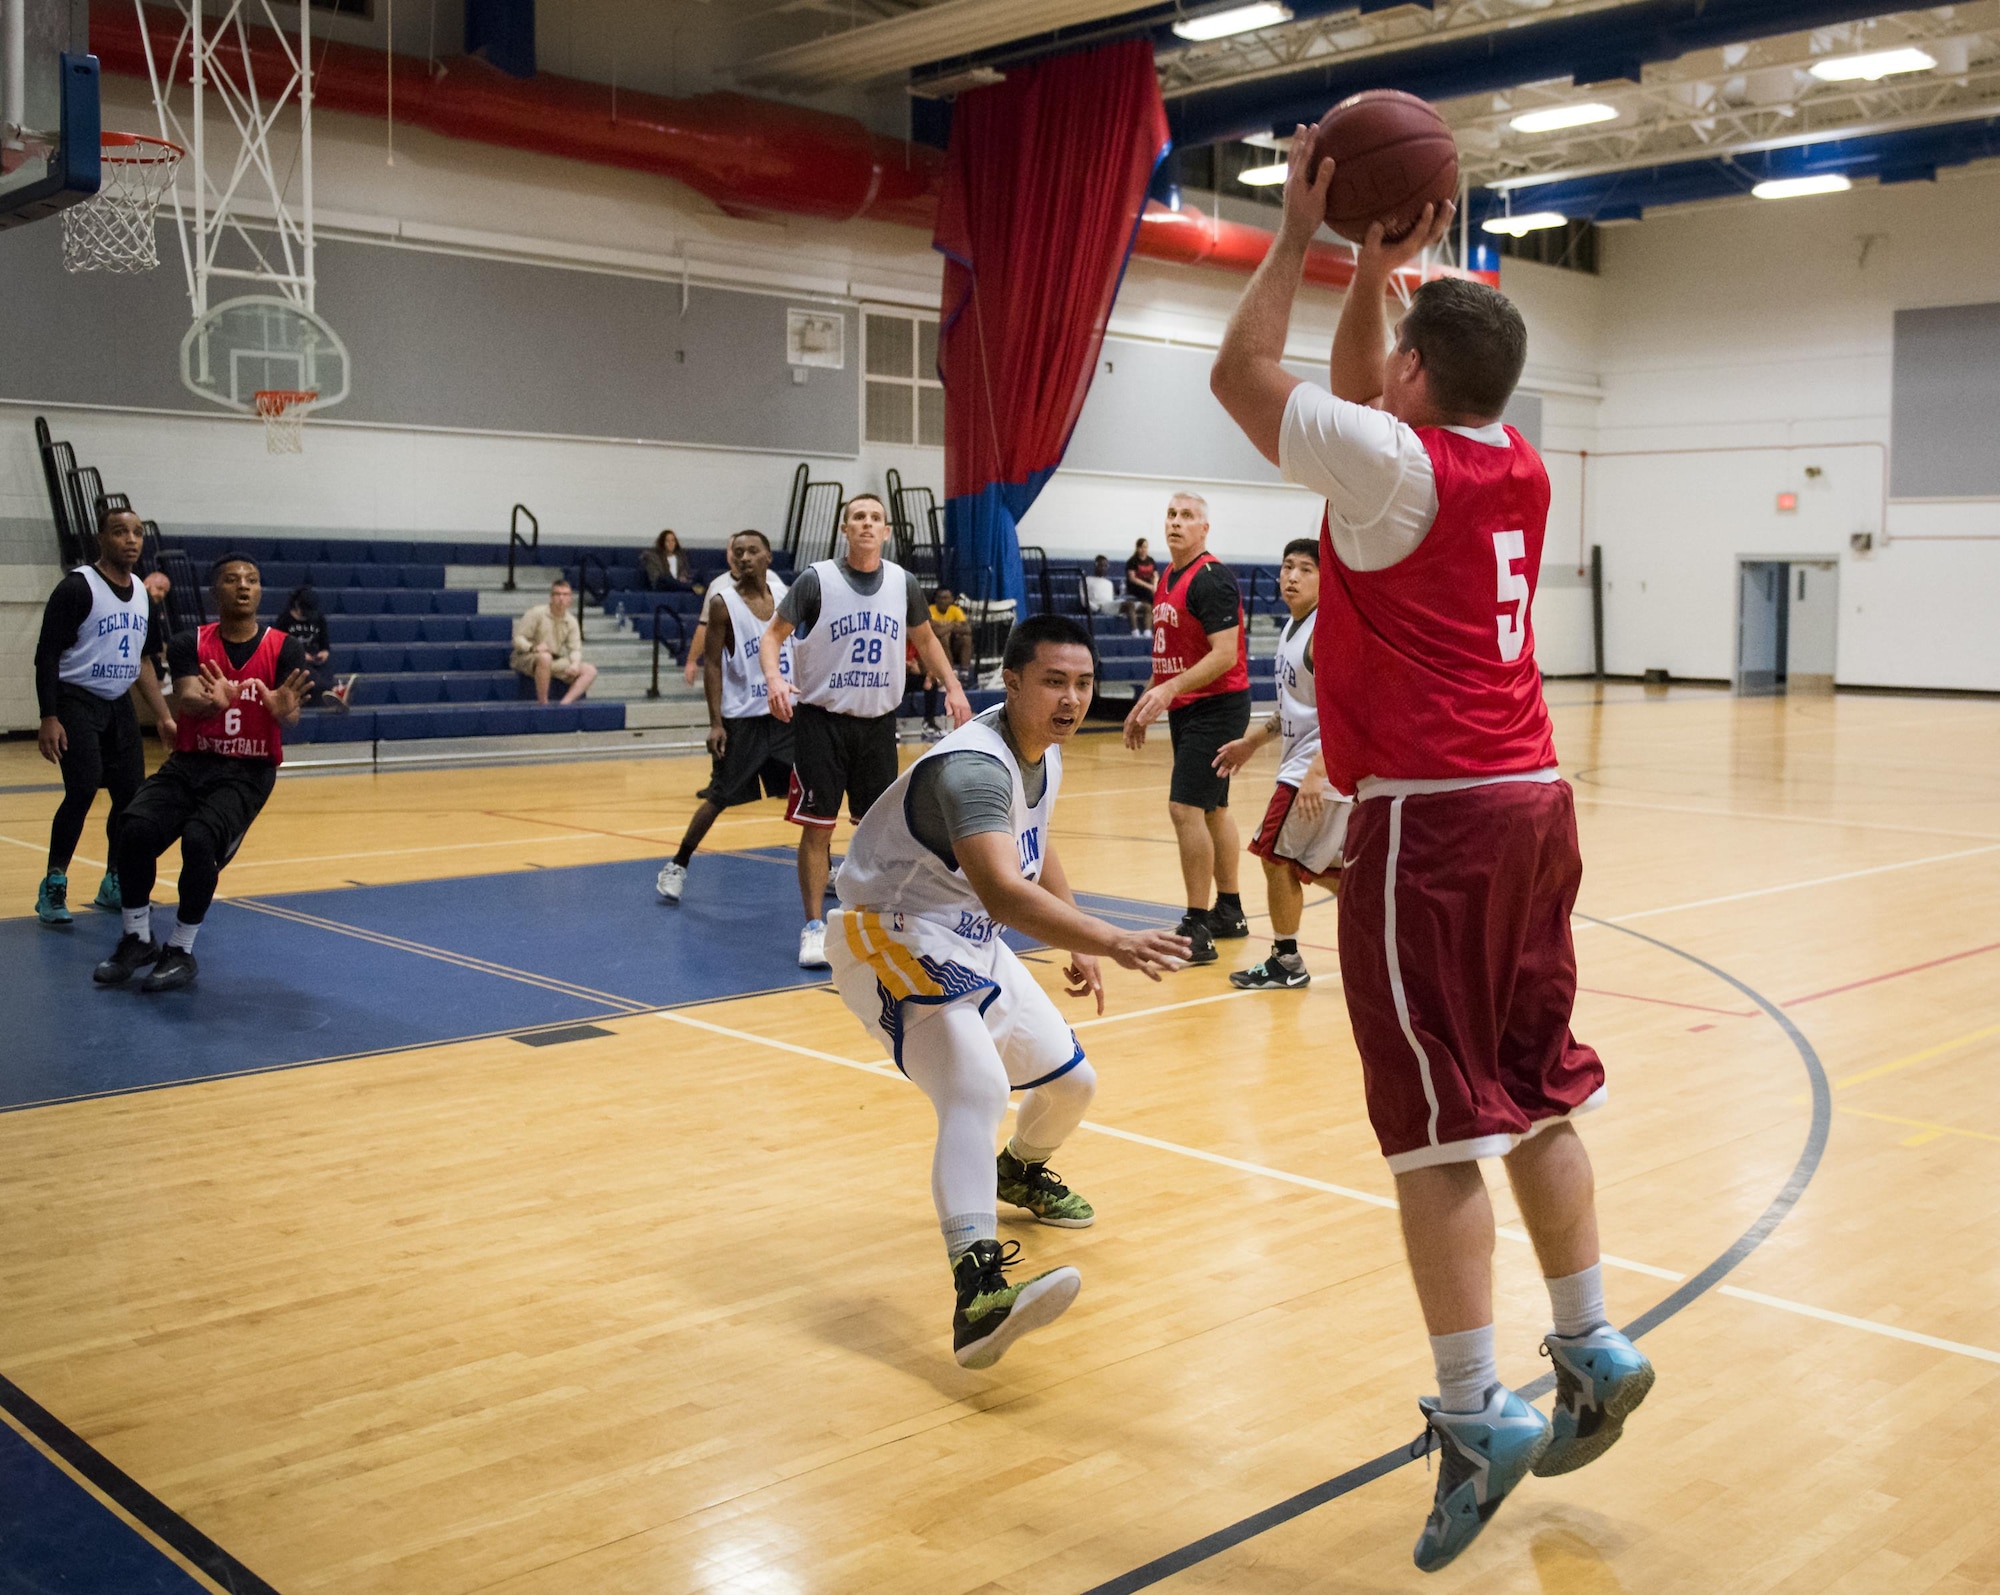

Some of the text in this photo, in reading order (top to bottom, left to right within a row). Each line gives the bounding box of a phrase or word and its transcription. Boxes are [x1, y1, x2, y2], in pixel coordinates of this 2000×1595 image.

[1492, 529, 1529, 663] 5
[97, 612, 129, 637] EGLIN
[830, 611, 899, 643] EGLIN AFB
[118, 634, 130, 658] 4
[851, 637, 882, 665] 28
[779, 653, 790, 675] 5
[829, 670, 890, 689] BASKETBALL
[225, 708, 242, 736] 6
